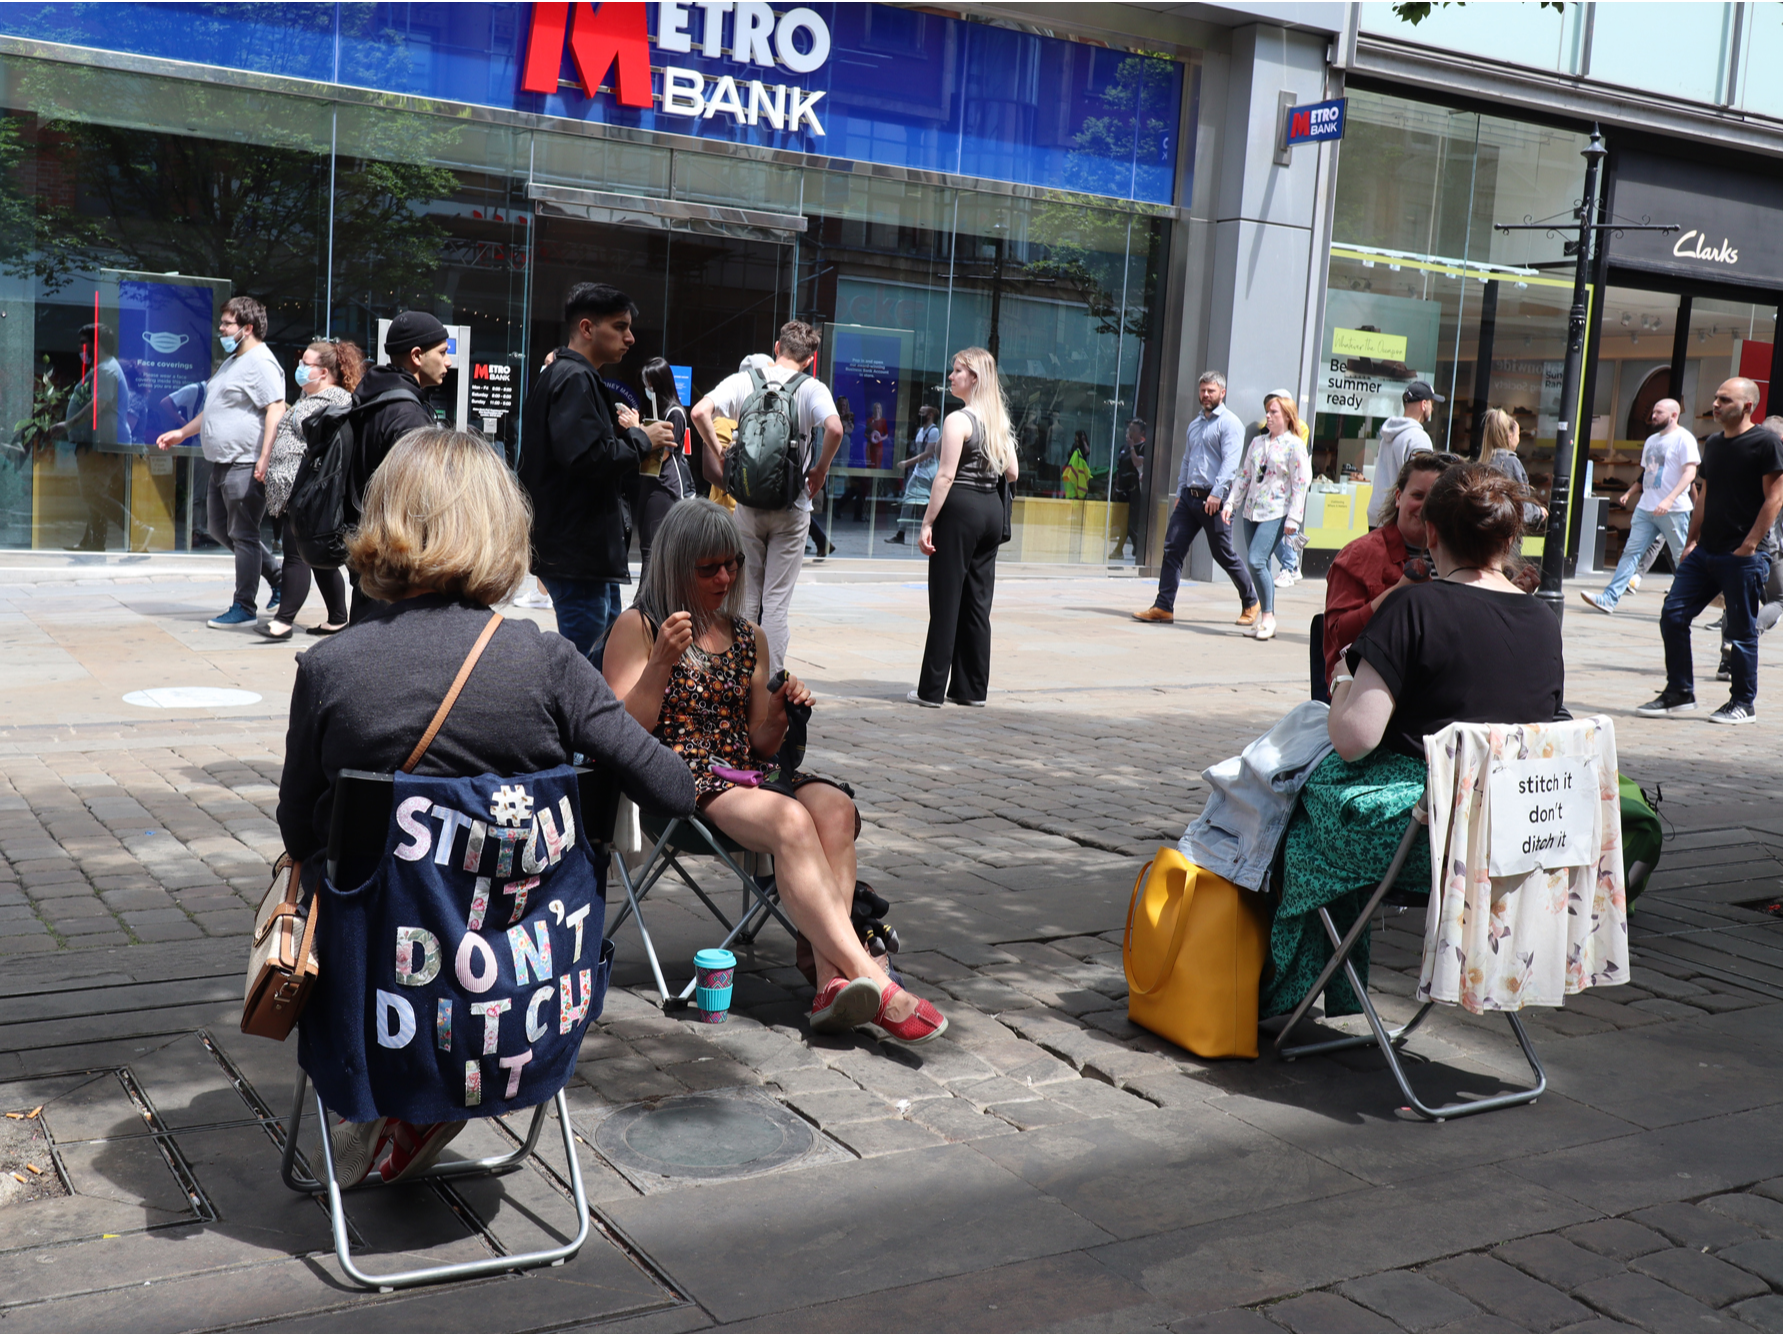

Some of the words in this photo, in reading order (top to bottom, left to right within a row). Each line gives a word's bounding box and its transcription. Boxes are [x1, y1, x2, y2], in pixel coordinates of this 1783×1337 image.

[520, 2, 831, 108] METRO
[662, 66, 826, 136] BANK
[1290, 106, 1339, 139] METRO
[1310, 122, 1338, 136] BANK
[1673, 229, 1739, 265] Clarks
[137, 359, 156, 367] Face
[156, 360, 193, 370] coverings
[473, 363, 511, 380] METRO
[1330, 358, 1347, 373] Be
[489, 373, 510, 381] BANK
[1328, 377, 1382, 394] summer
[1326, 393, 1363, 410] ready
[1518, 773, 1559, 794] stitch
[1563, 771, 1573, 790] it
[1528, 801, 1563, 824] don't
[392, 795, 577, 878] STITCH
[1521, 832, 1555, 854] ditch
[1556, 831, 1567, 848] it
[466, 875, 542, 931] IT
[395, 899, 591, 994] DON'T
[375, 968, 592, 1056] DITCH
[464, 1048, 533, 1107] IT
